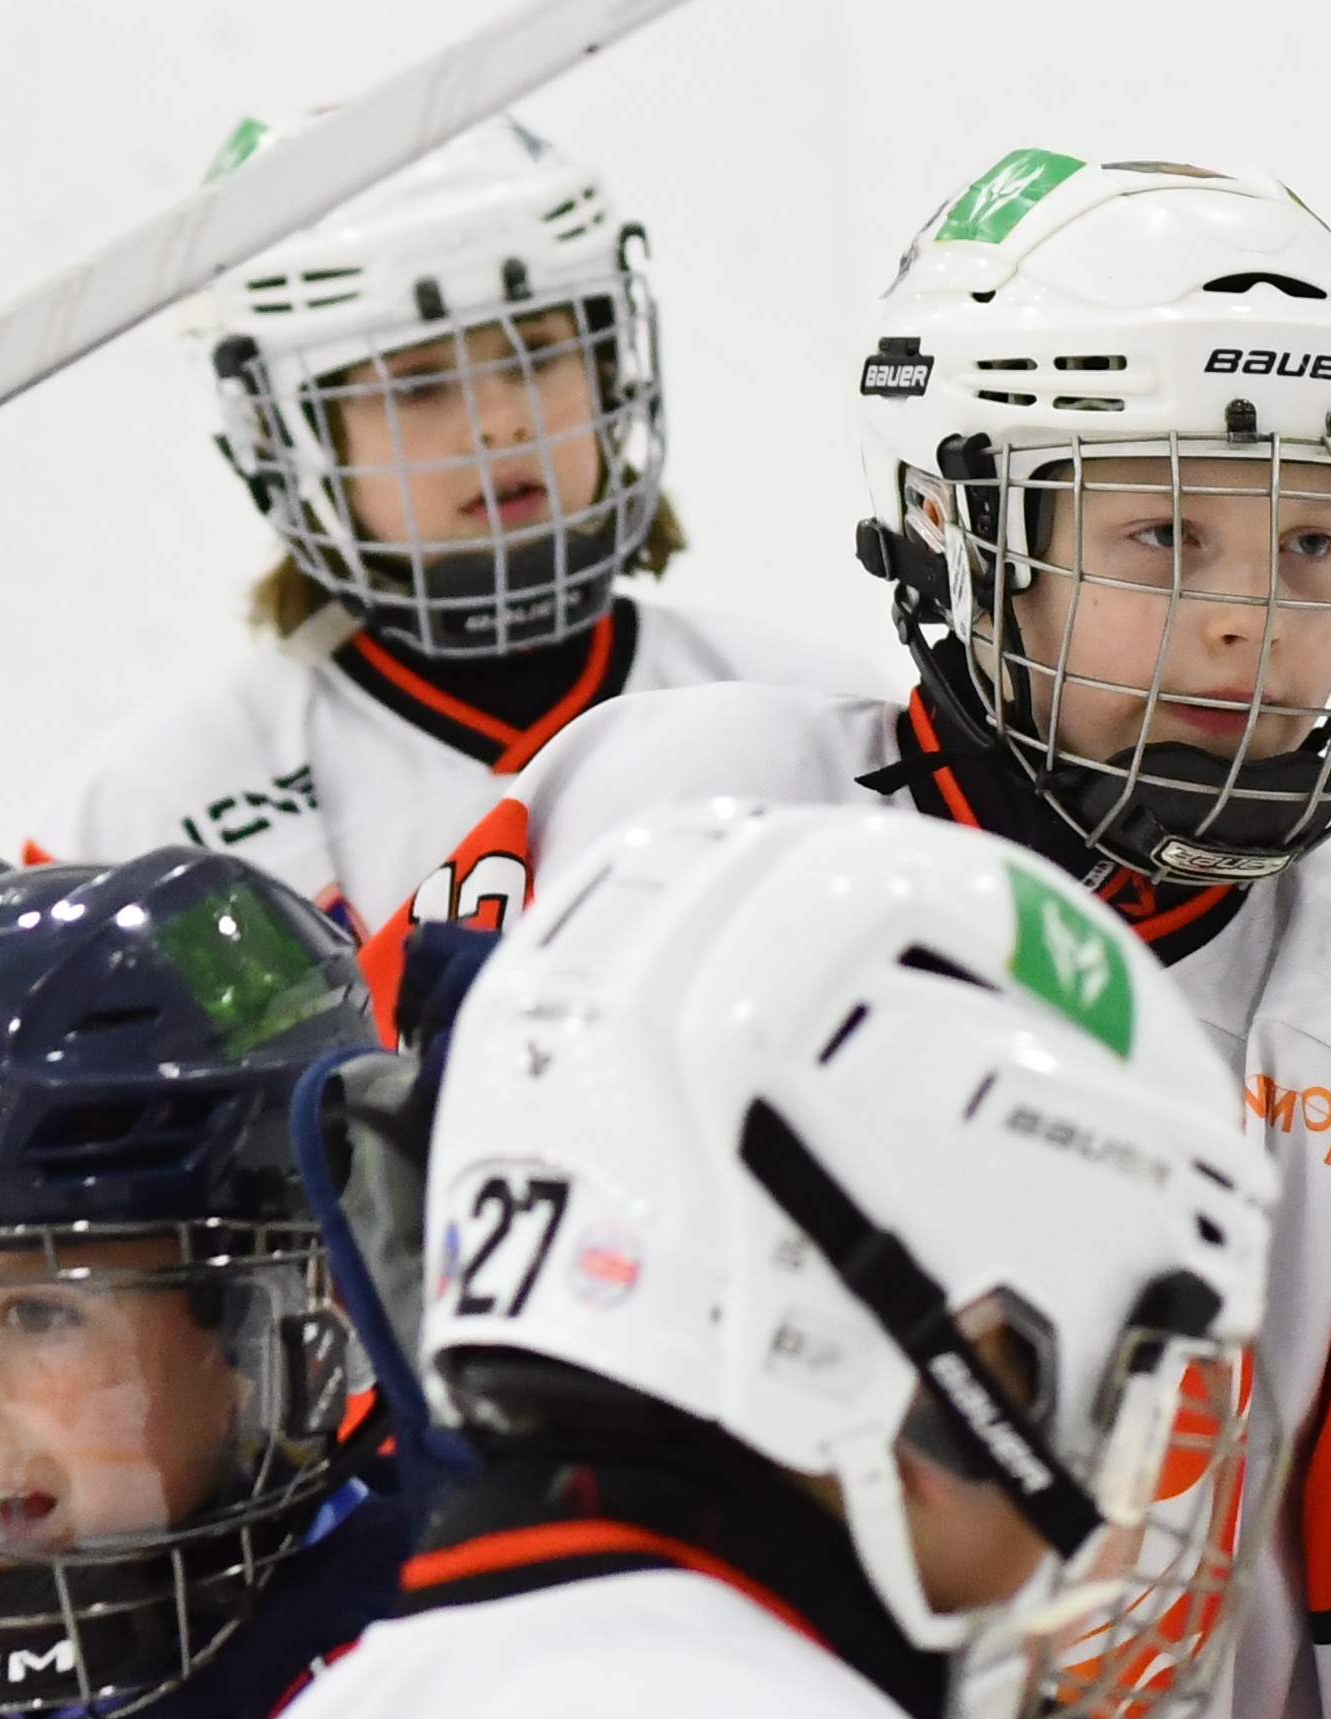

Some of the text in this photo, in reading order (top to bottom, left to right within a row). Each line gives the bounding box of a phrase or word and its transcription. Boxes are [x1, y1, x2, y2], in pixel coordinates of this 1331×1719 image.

[867, 363, 929, 389] BAUER
[454, 1176, 570, 1318] 27
[928, 1352, 1055, 1496] BAUER
